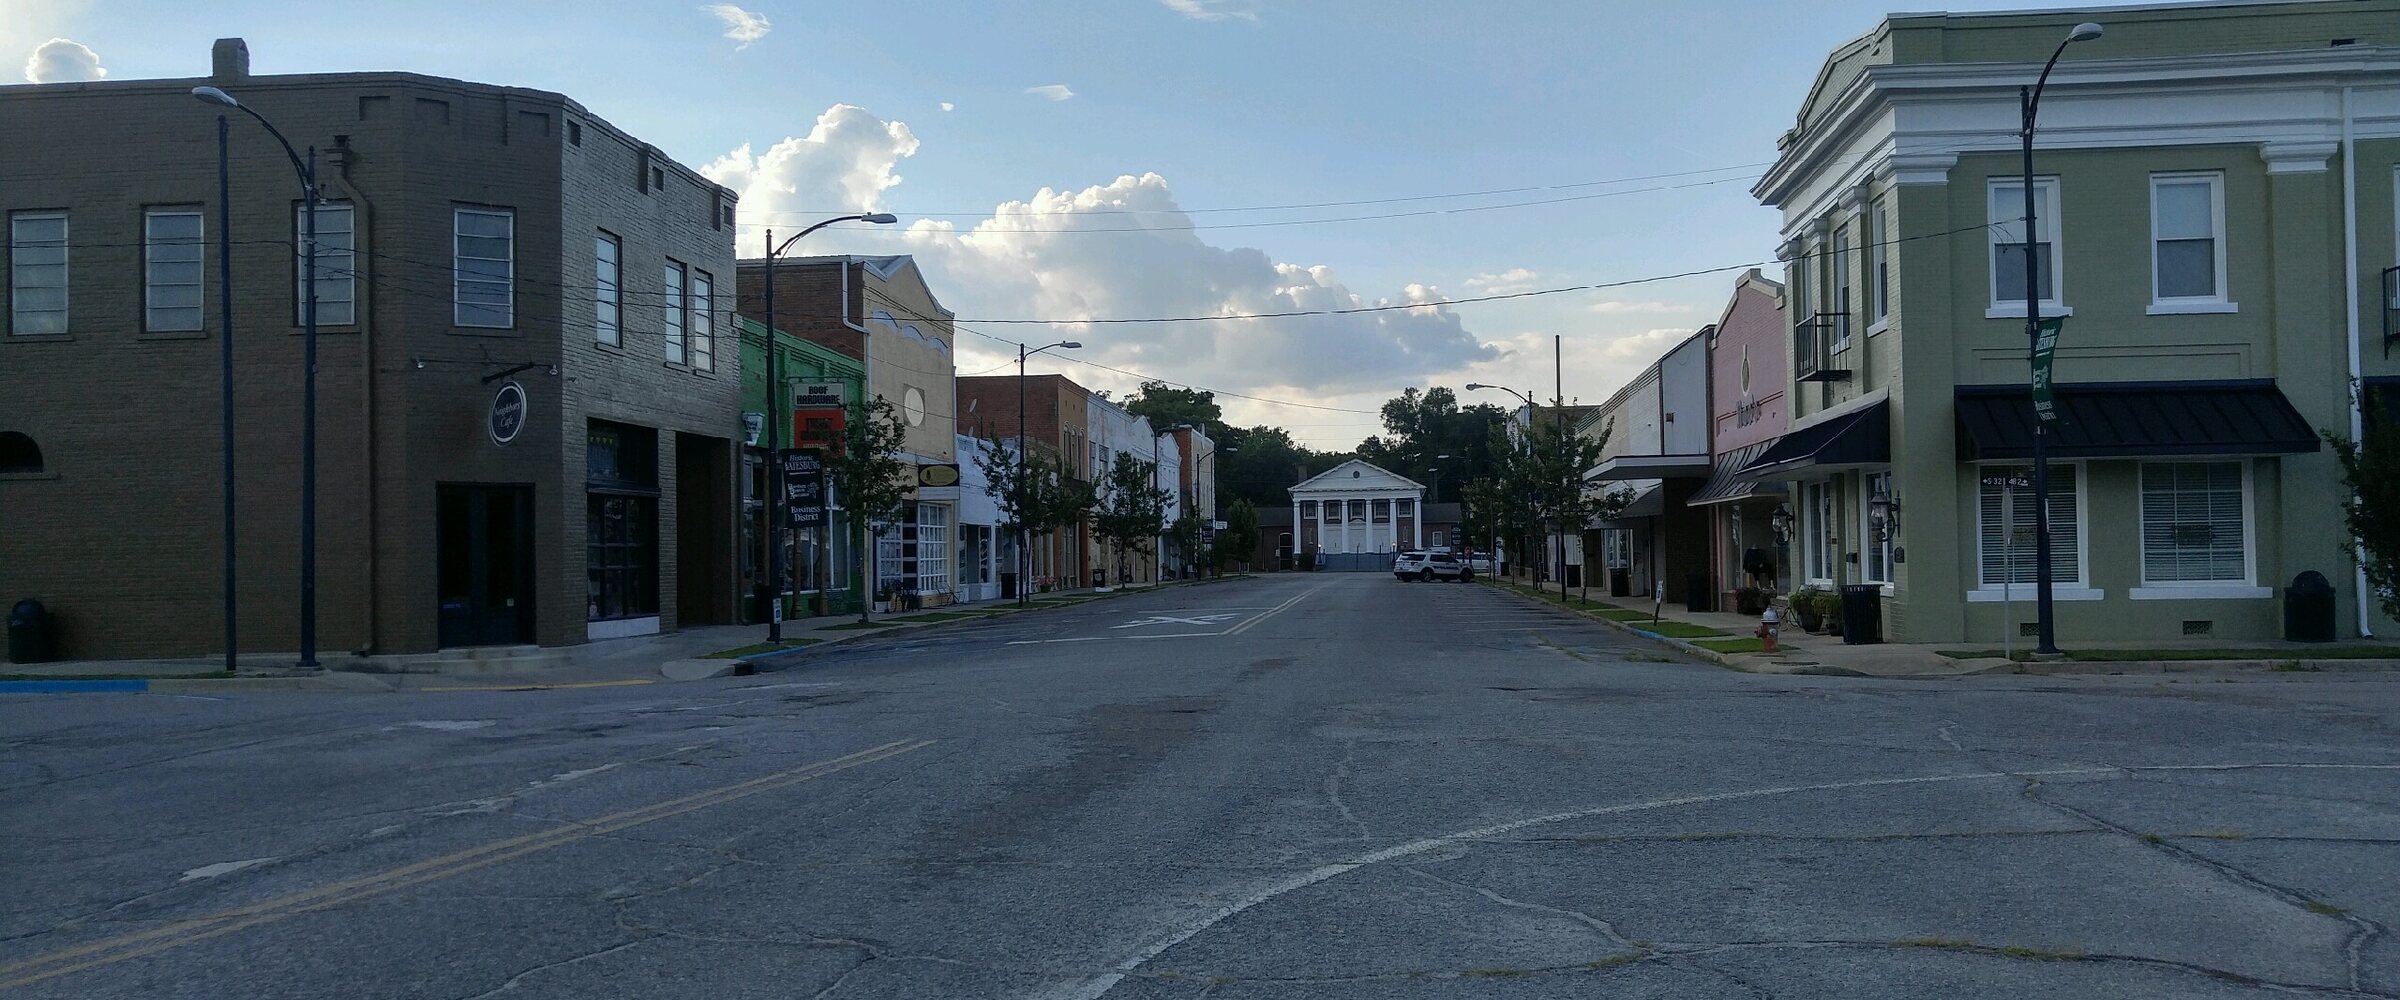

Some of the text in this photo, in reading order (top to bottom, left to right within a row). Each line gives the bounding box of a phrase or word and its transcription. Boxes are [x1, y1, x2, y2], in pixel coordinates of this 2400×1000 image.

[796, 394, 840, 405] HARDWARE
[789, 454, 814, 462] Historic
[790, 505, 822, 514] Business
[794, 513, 819, 522] District
